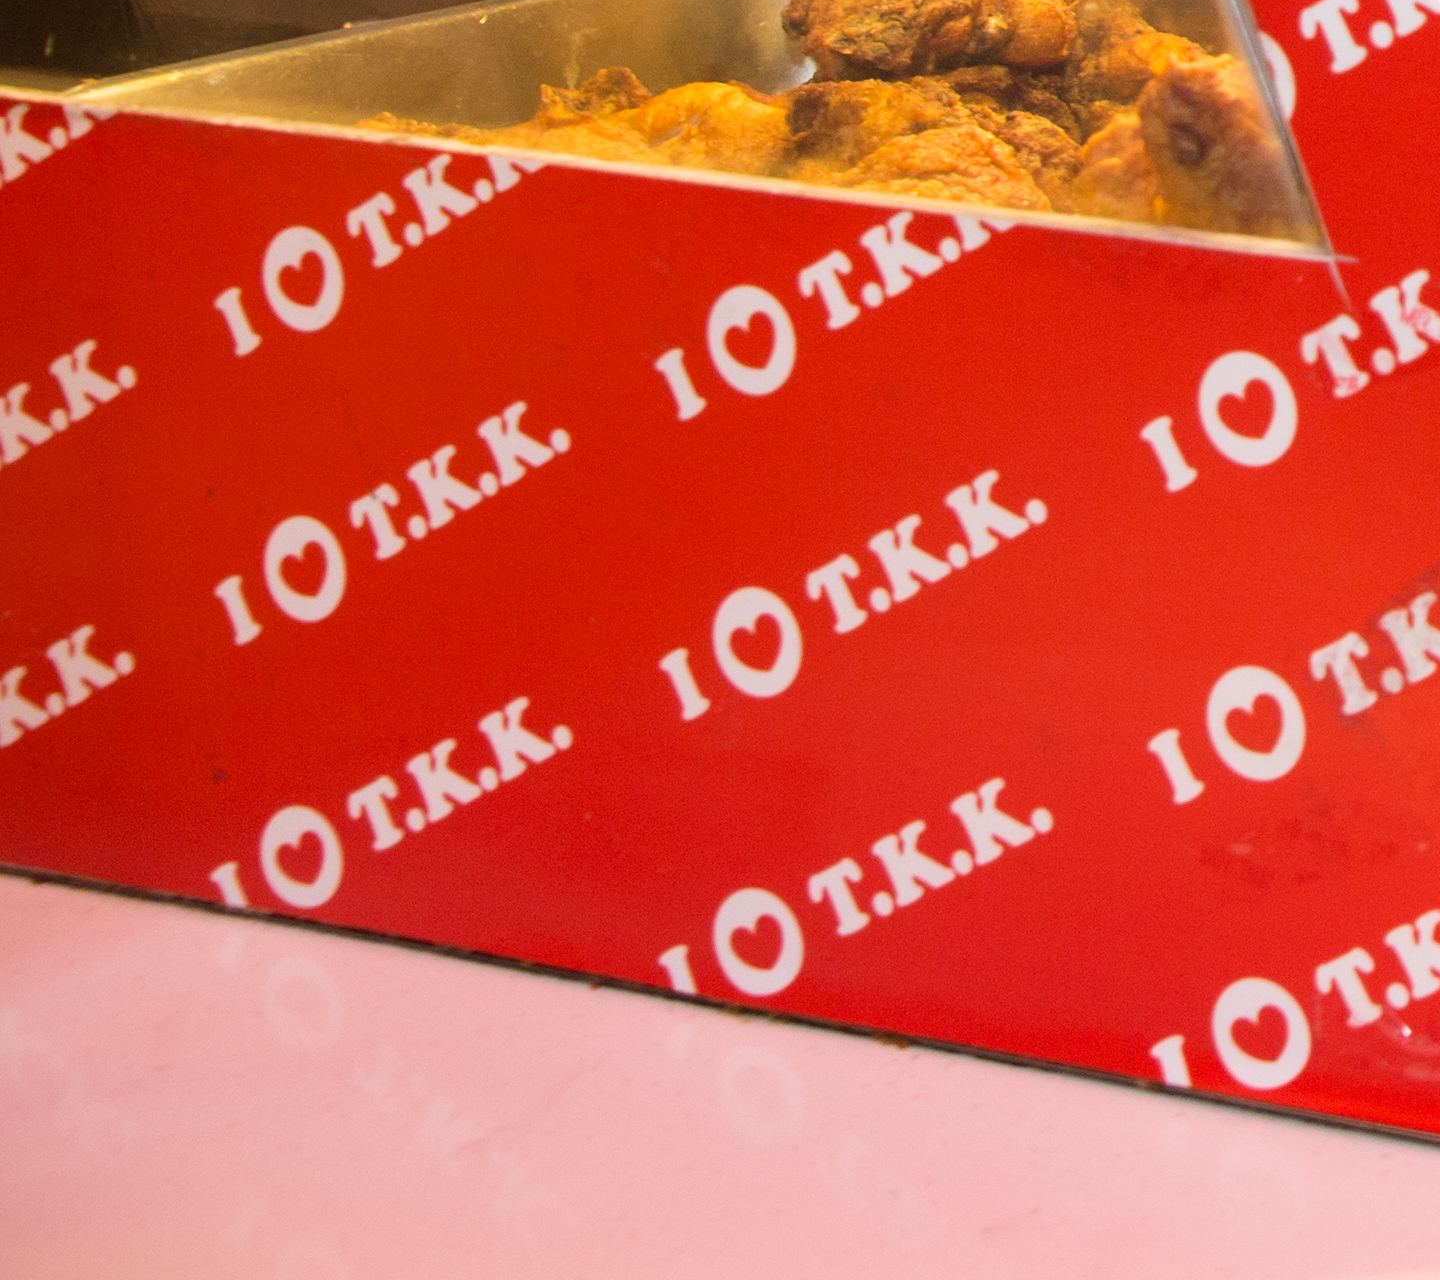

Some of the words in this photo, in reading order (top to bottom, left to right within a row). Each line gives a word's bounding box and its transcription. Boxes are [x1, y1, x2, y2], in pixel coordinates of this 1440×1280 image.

[349, 401, 572, 561] T.K.K.
[805, 470, 1049, 634] T.K.K.
[347, 696, 573, 852] T.K.K.
[807, 778, 1055, 937] T.K.K.
